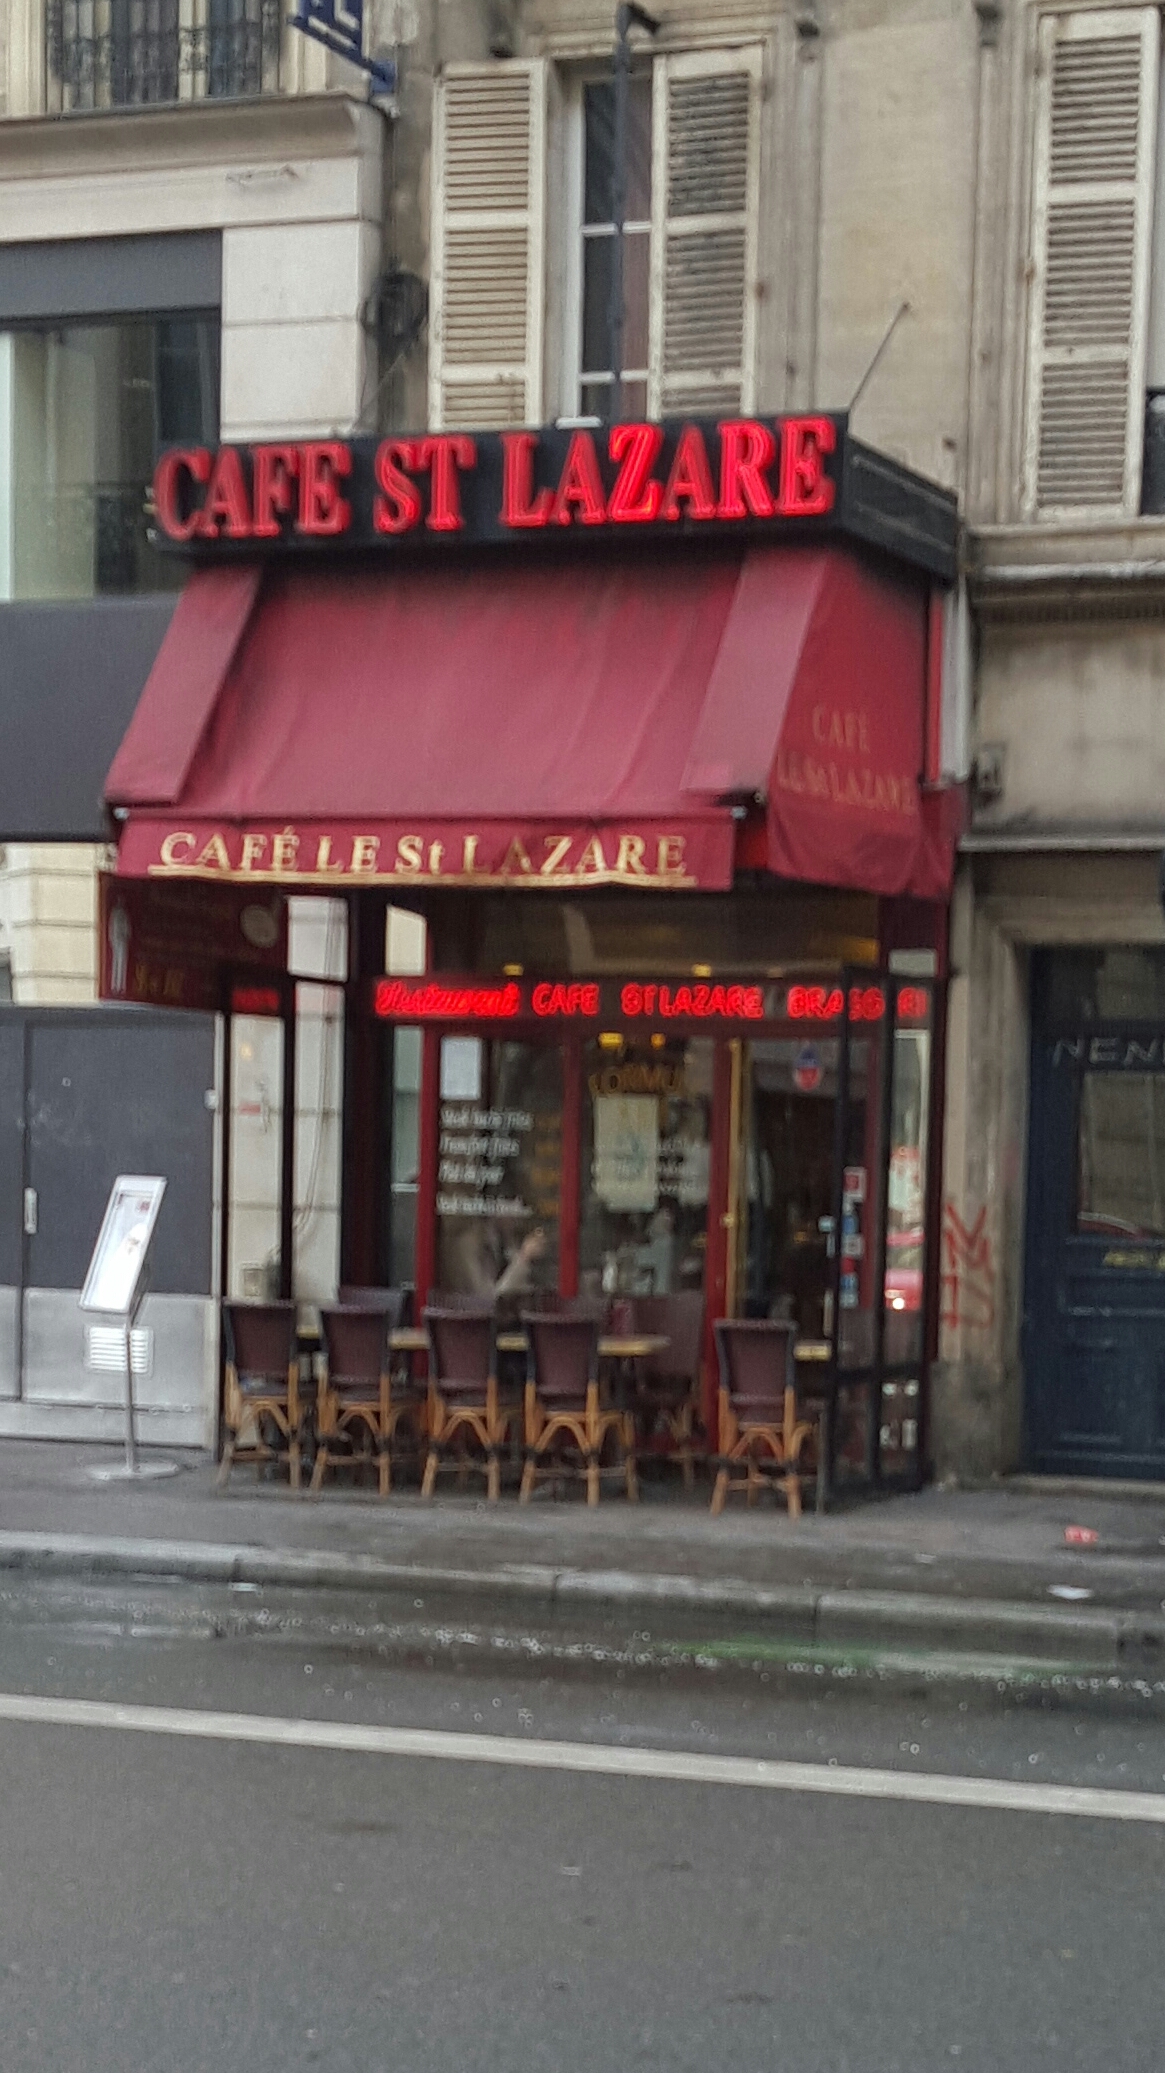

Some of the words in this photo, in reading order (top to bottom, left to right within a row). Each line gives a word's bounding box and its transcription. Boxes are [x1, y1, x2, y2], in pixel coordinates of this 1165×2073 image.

[152, 438, 352, 541] CAFE
[373, 433, 476, 534] ST
[499, 416, 836, 529] LAZARE
[160, 825, 300, 872] CAFÉ
[316, 835, 381, 874] LE
[395, 834, 445, 876] St
[463, 834, 687, 877] LAZARE
[532, 983, 599, 1016] CAFE
